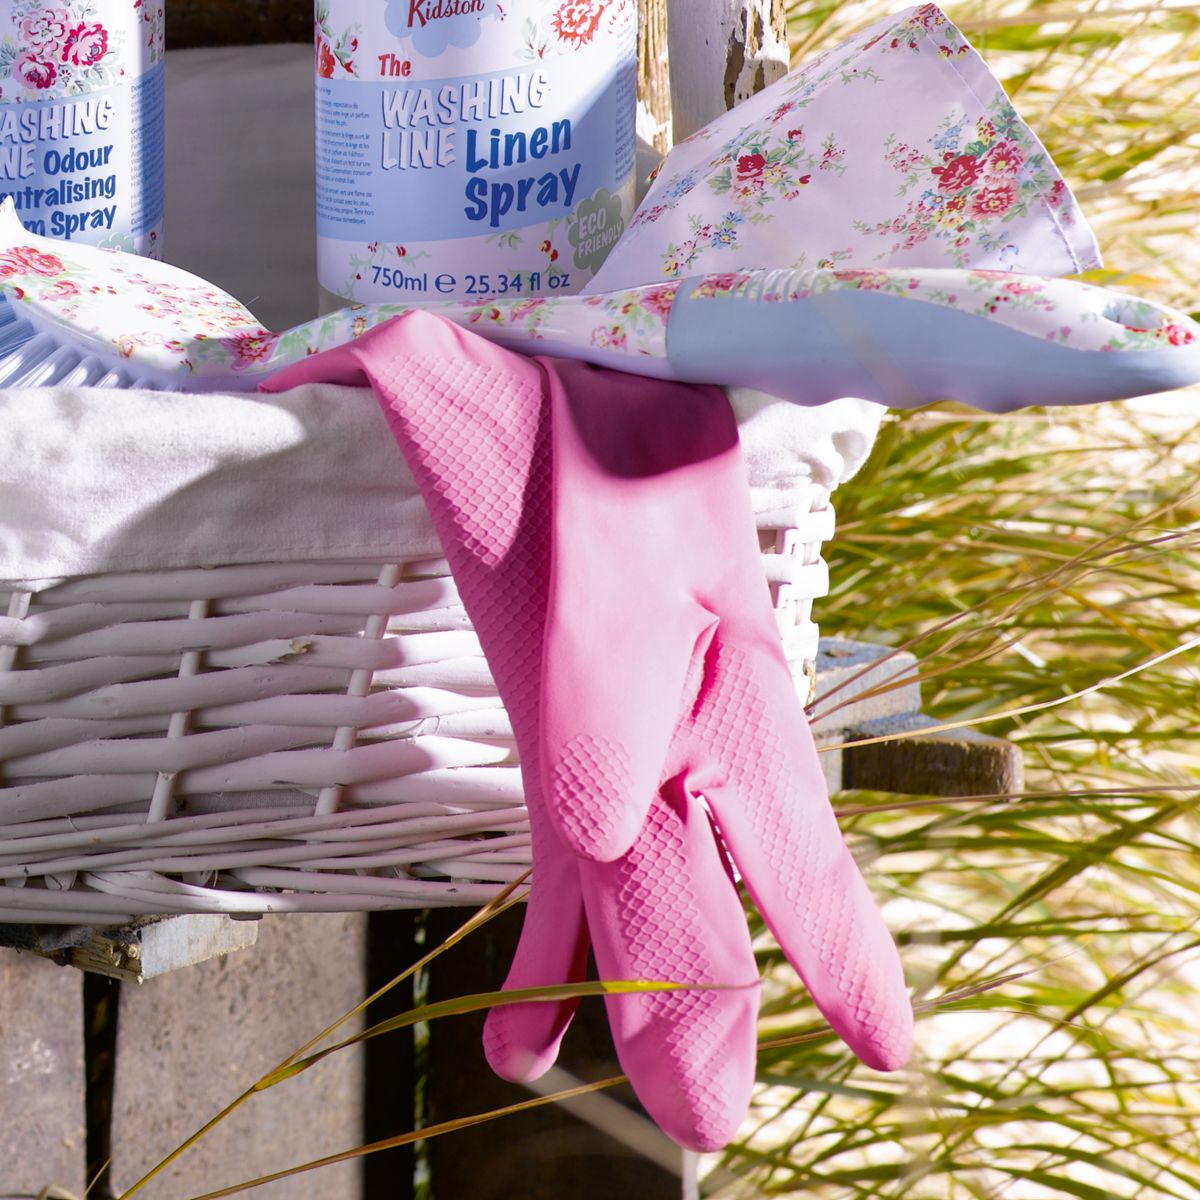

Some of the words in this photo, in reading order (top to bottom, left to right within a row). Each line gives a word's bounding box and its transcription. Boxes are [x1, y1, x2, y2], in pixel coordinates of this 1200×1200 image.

[378, 53, 412, 77] The
[382, 70, 550, 130] WASHING
[43, 144, 113, 176] Odour
[381, 127, 456, 171] LINE
[466, 118, 572, 174] Linen
[464, 164, 582, 228] Spray
[50, 205, 117, 240] Spray
[578, 207, 607, 237] ECO
[578, 221, 623, 258] FRIENDLY
[372, 265, 427, 292] 750ml
[465, 272, 523, 294] 25.34
[530, 271, 541, 291] fl
[548, 272, 570, 288] oz
